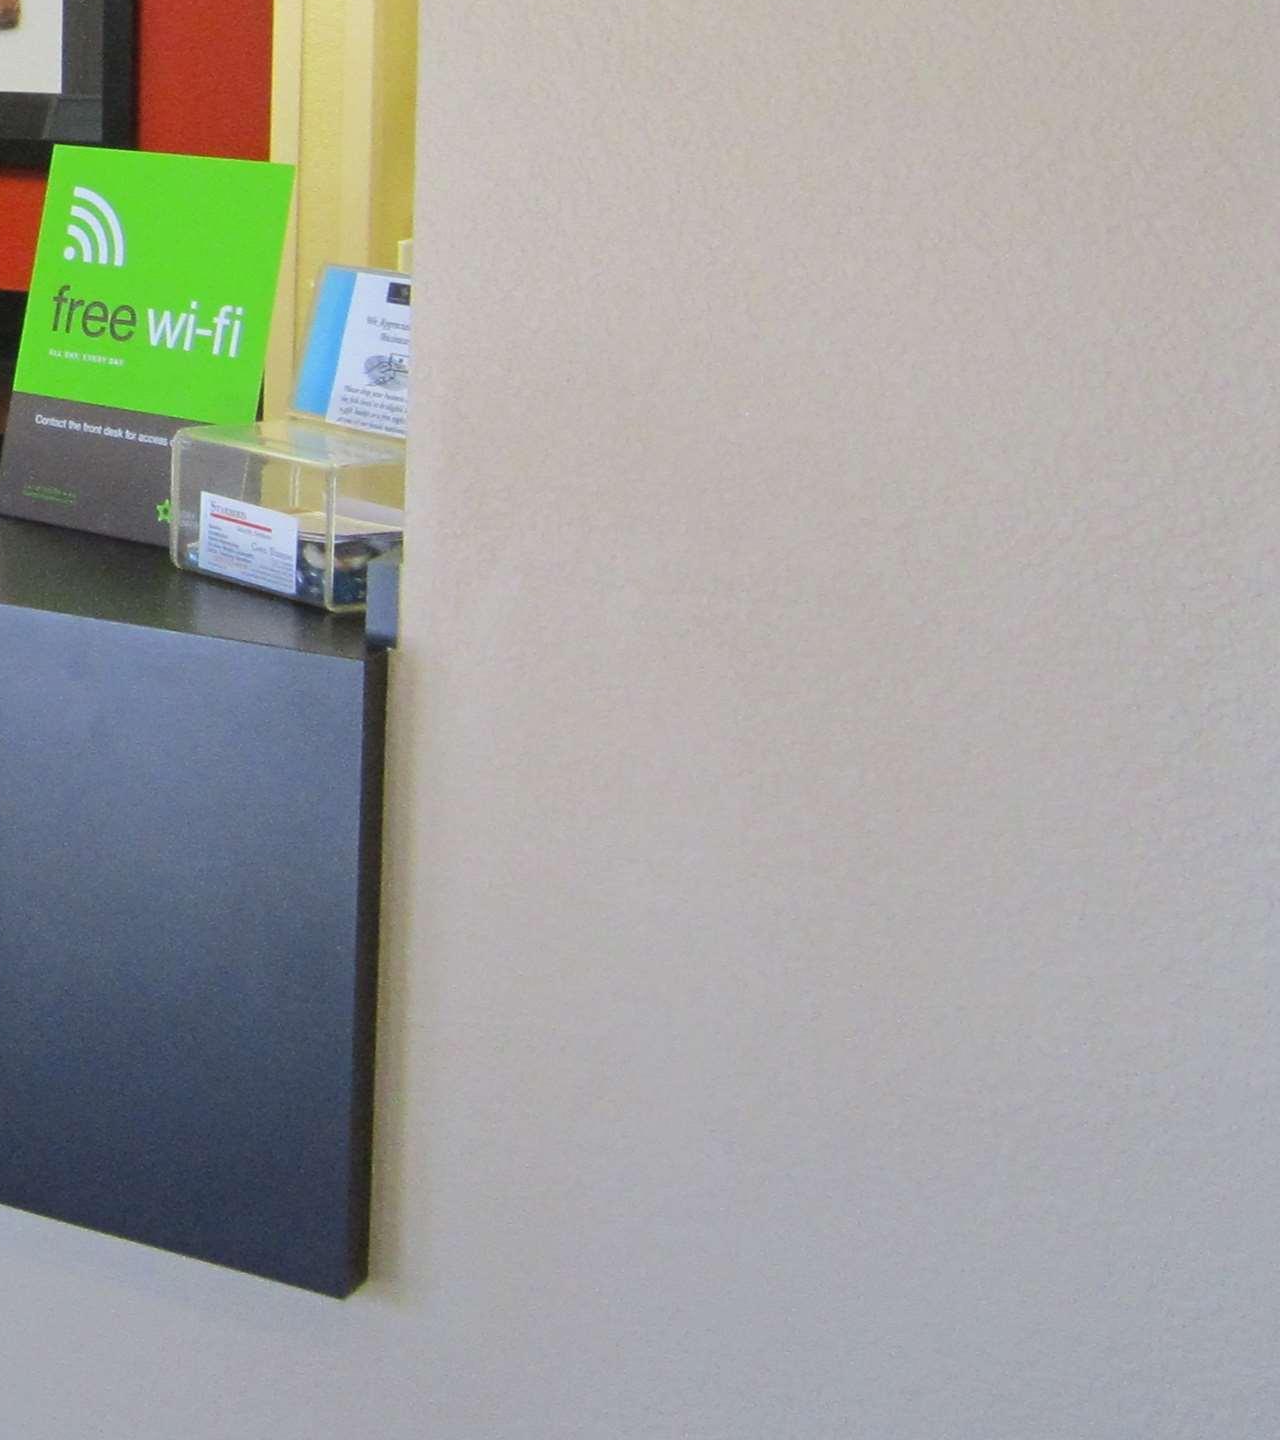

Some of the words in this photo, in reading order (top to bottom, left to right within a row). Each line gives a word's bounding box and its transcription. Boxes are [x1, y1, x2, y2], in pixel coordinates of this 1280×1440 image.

[52, 285, 137, 342] free
[147, 300, 244, 358] wi-fi
[35, 414, 67, 429] Contact
[68, 419, 81, 431] the
[83, 422, 102, 434] front
[103, 426, 123, 438] desk
[125, 429, 137, 440] for
[138, 433, 168, 446] access
